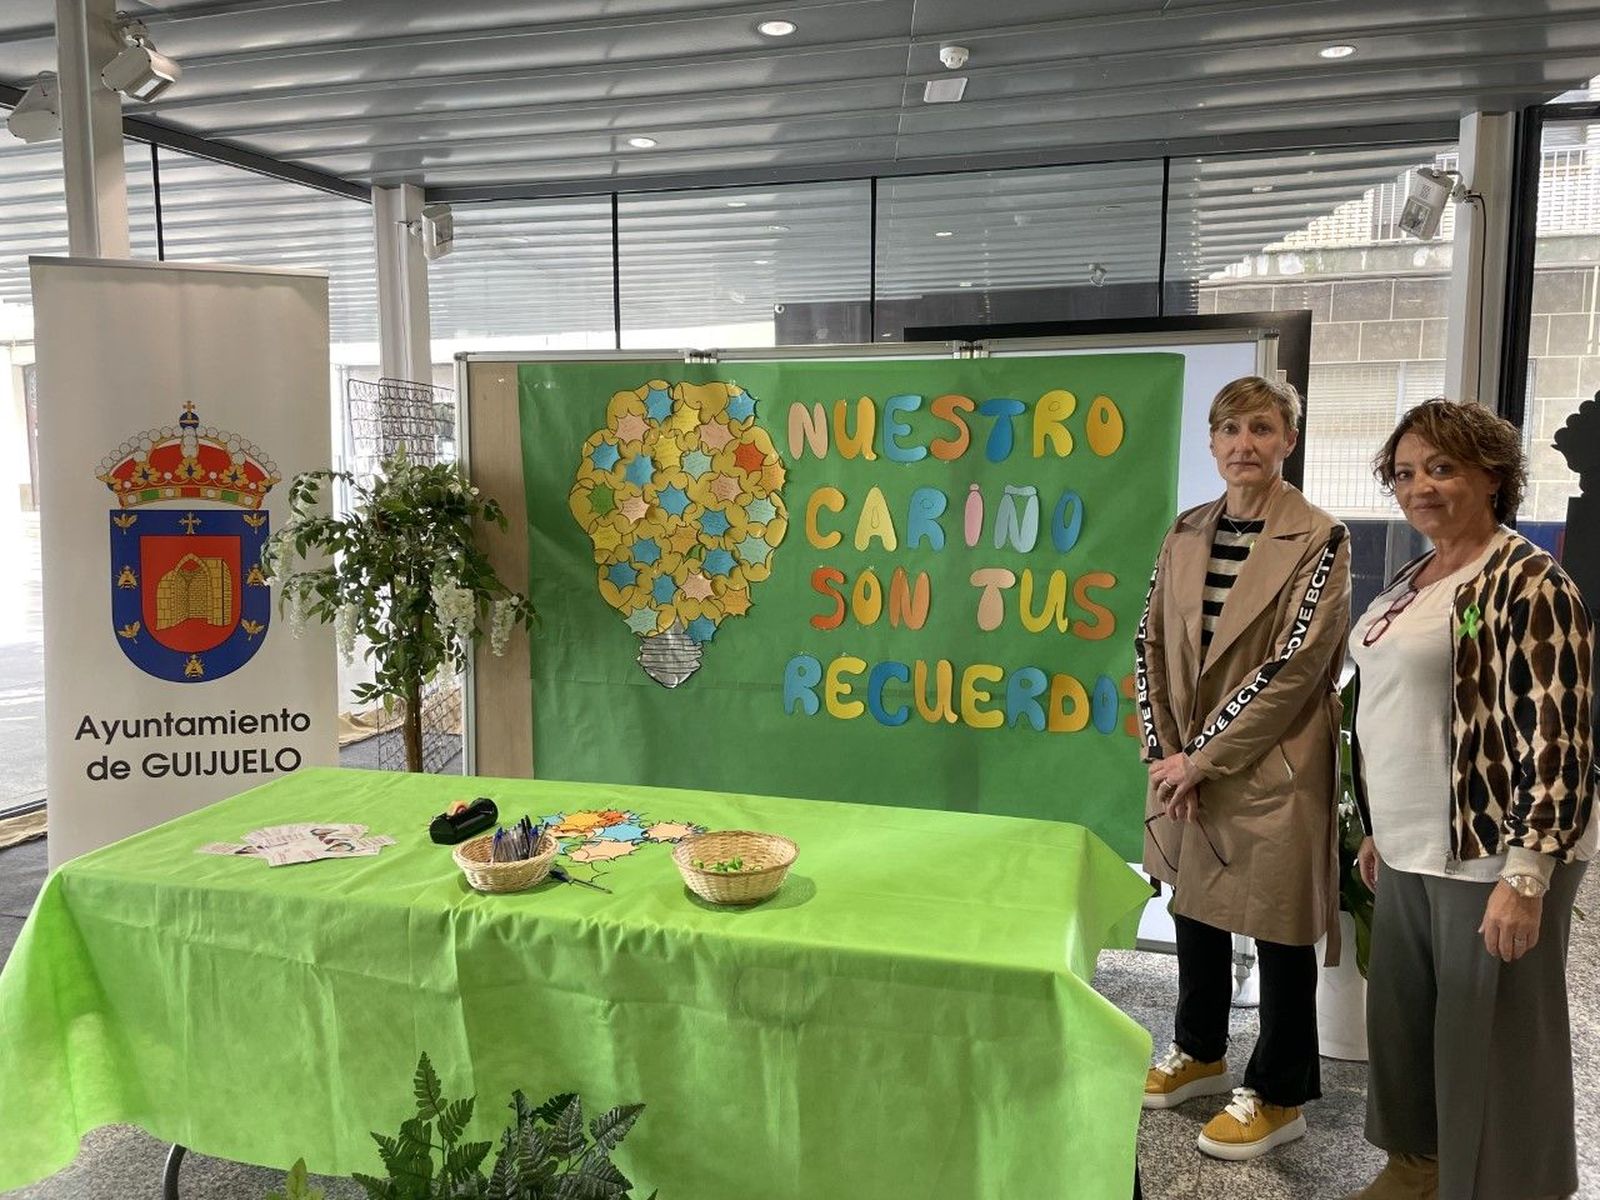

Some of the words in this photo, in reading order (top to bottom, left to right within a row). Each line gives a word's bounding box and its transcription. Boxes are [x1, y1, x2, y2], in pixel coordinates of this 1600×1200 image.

[788, 389, 1125, 463] NUESTRO
[805, 483, 1083, 553] CARIÑO
[810, 566, 931, 630] SON
[969, 567, 1117, 640] TUS
[1280, 607, 1313, 660] LOVE
[1305, 547, 1335, 603] BCTT
[74, 708, 311, 745] Ayuntamiento
[1225, 672, 1268, 716] BCTT
[86, 755, 131, 781] de
[142, 747, 302, 778] GUIJUELO
